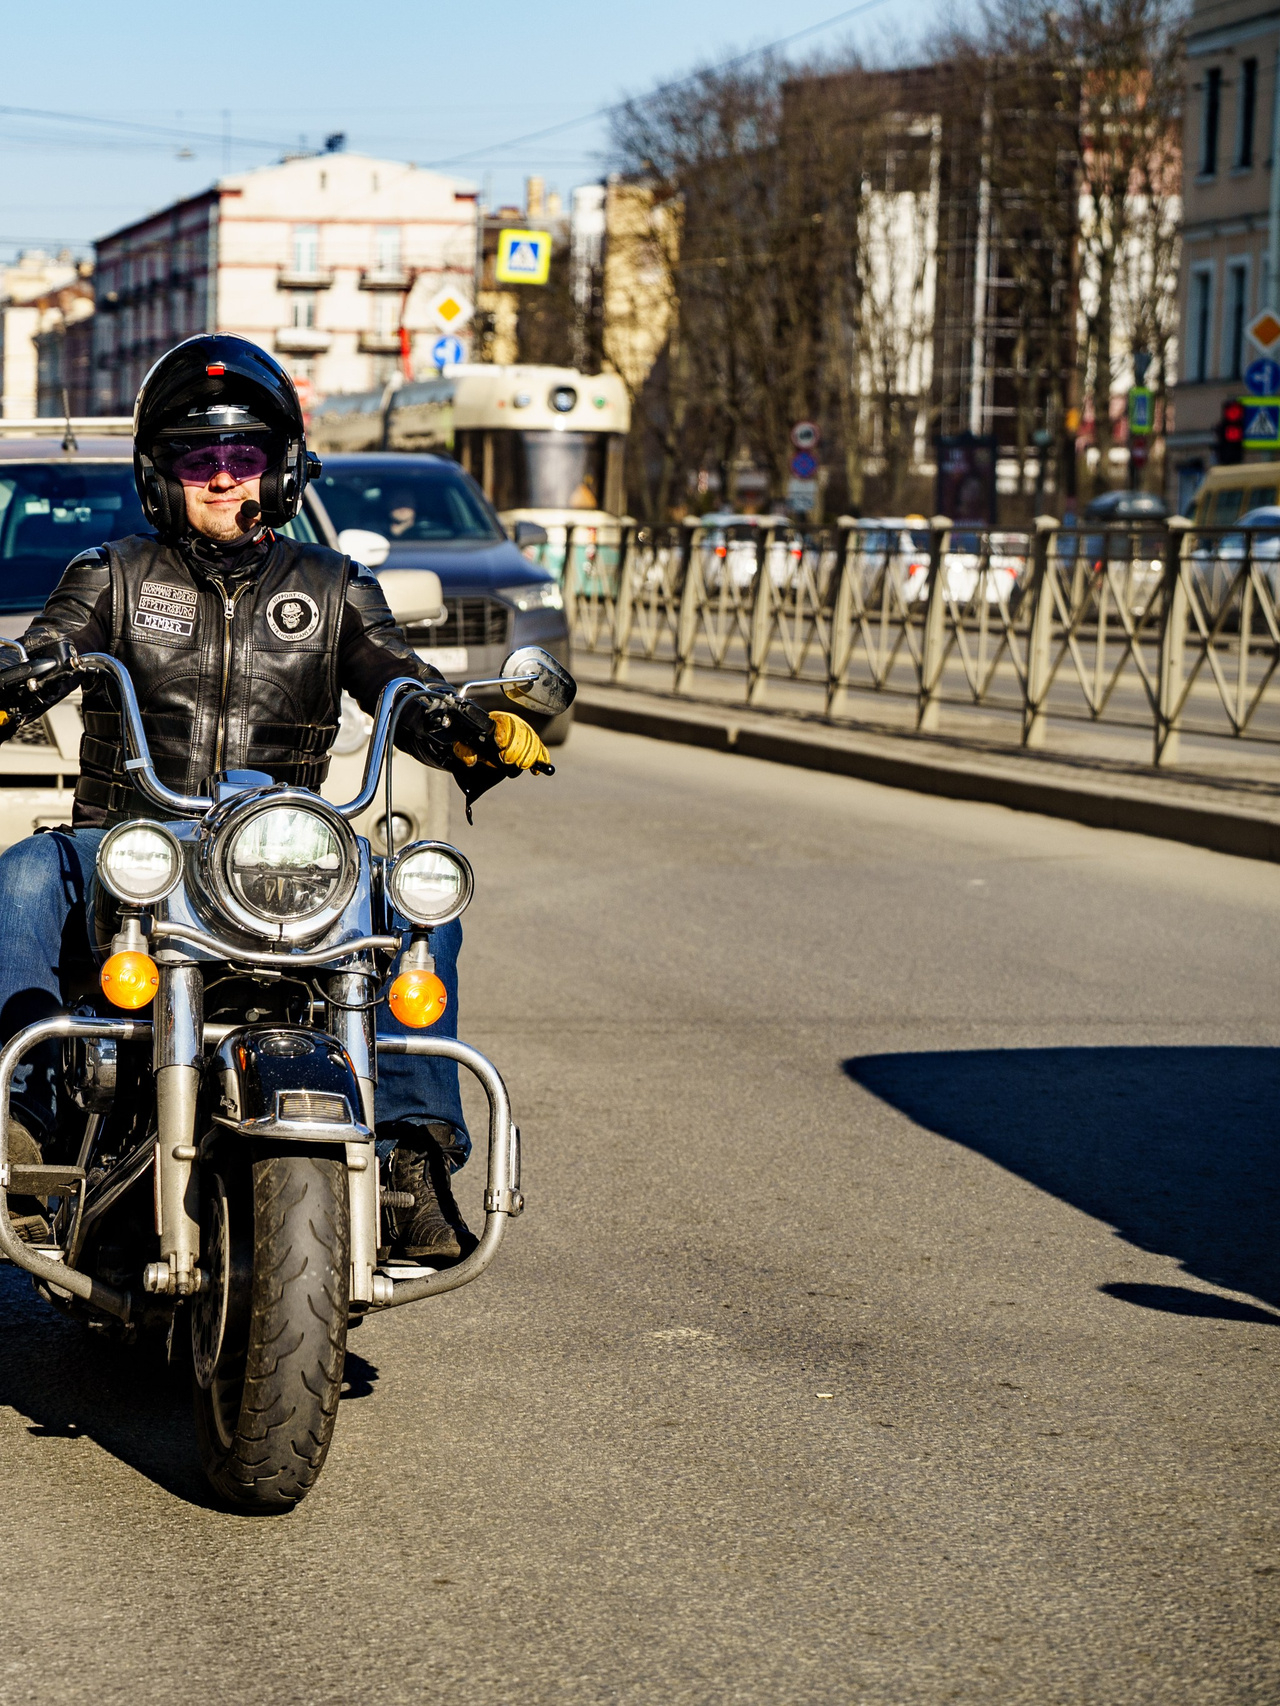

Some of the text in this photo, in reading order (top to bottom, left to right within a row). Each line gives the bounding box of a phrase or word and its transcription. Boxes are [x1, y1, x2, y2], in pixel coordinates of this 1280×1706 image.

[187, 404, 250, 417] LS2
[272, 593, 297, 604] SUPPORT
[144, 615, 182, 633] MEMBER
